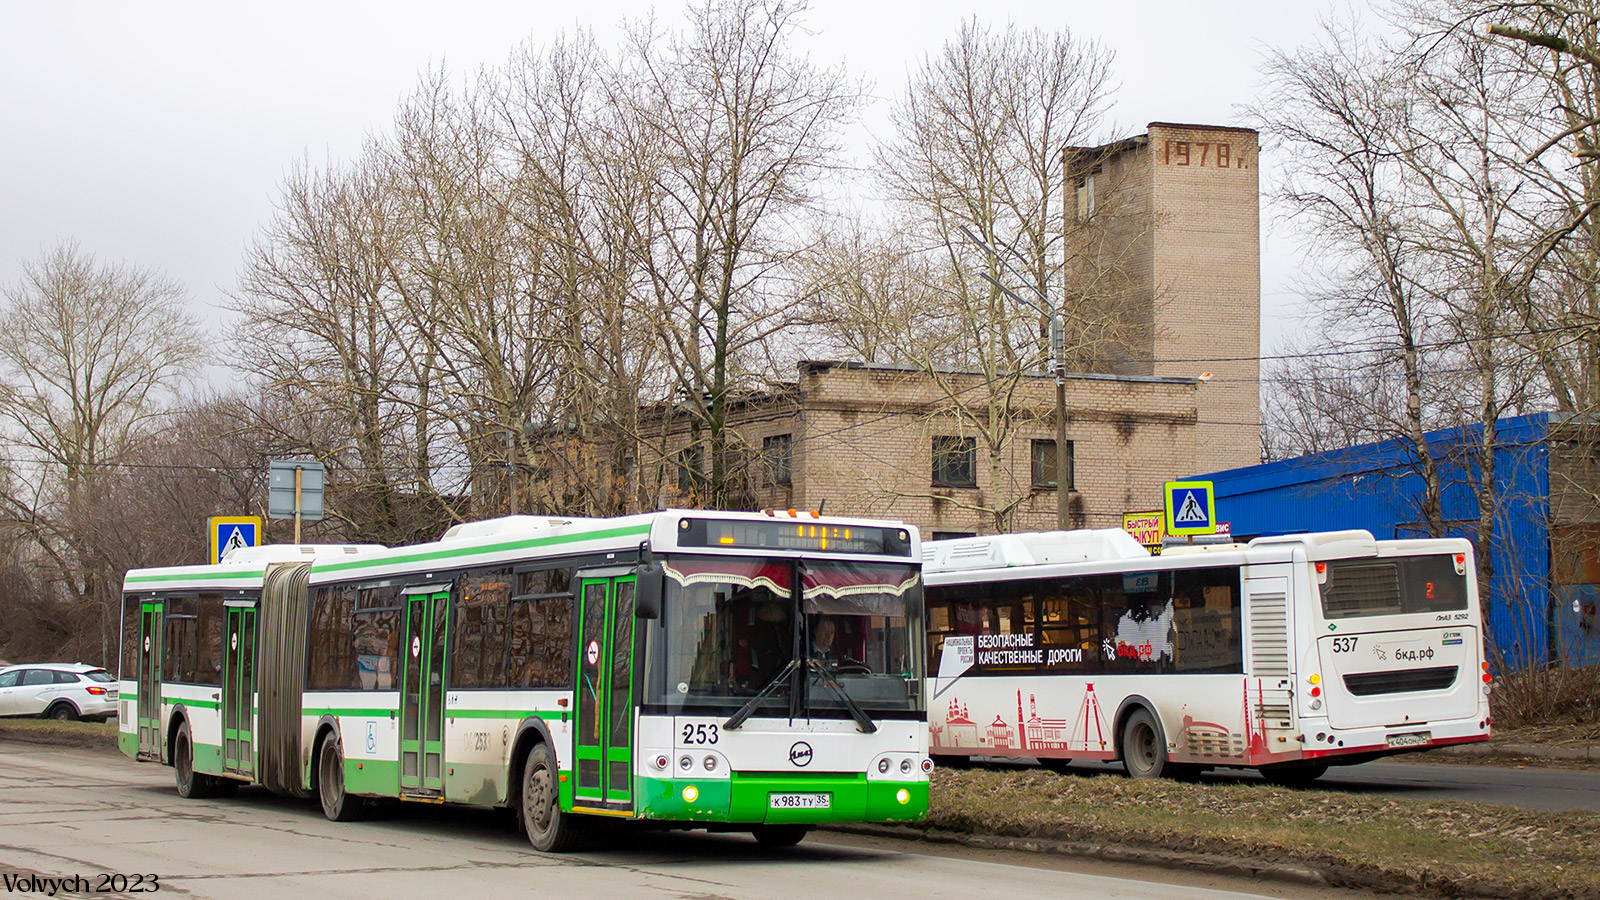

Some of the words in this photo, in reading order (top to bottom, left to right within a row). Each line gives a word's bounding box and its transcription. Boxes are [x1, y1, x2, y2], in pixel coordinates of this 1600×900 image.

[1164, 141, 1230, 168] 1978
[1127, 516, 1159, 530] БЫСТРЫЙ
[1425, 582, 1434, 599] 2
[1454, 613, 1469, 621] 5292
[977, 633, 1033, 648] БЕЗОПАСНЫЕ
[1332, 637, 1359, 653] 537
[978, 649, 1043, 664] КАЧЕСТВЕННЫЕ
[1047, 648, 1082, 666] ДОРОГИ
[1117, 640, 1152, 660] бкд.рф
[1395, 646, 1434, 661] бкд.рф
[683, 723, 719, 744] 253
[816, 795, 827, 804] 35
